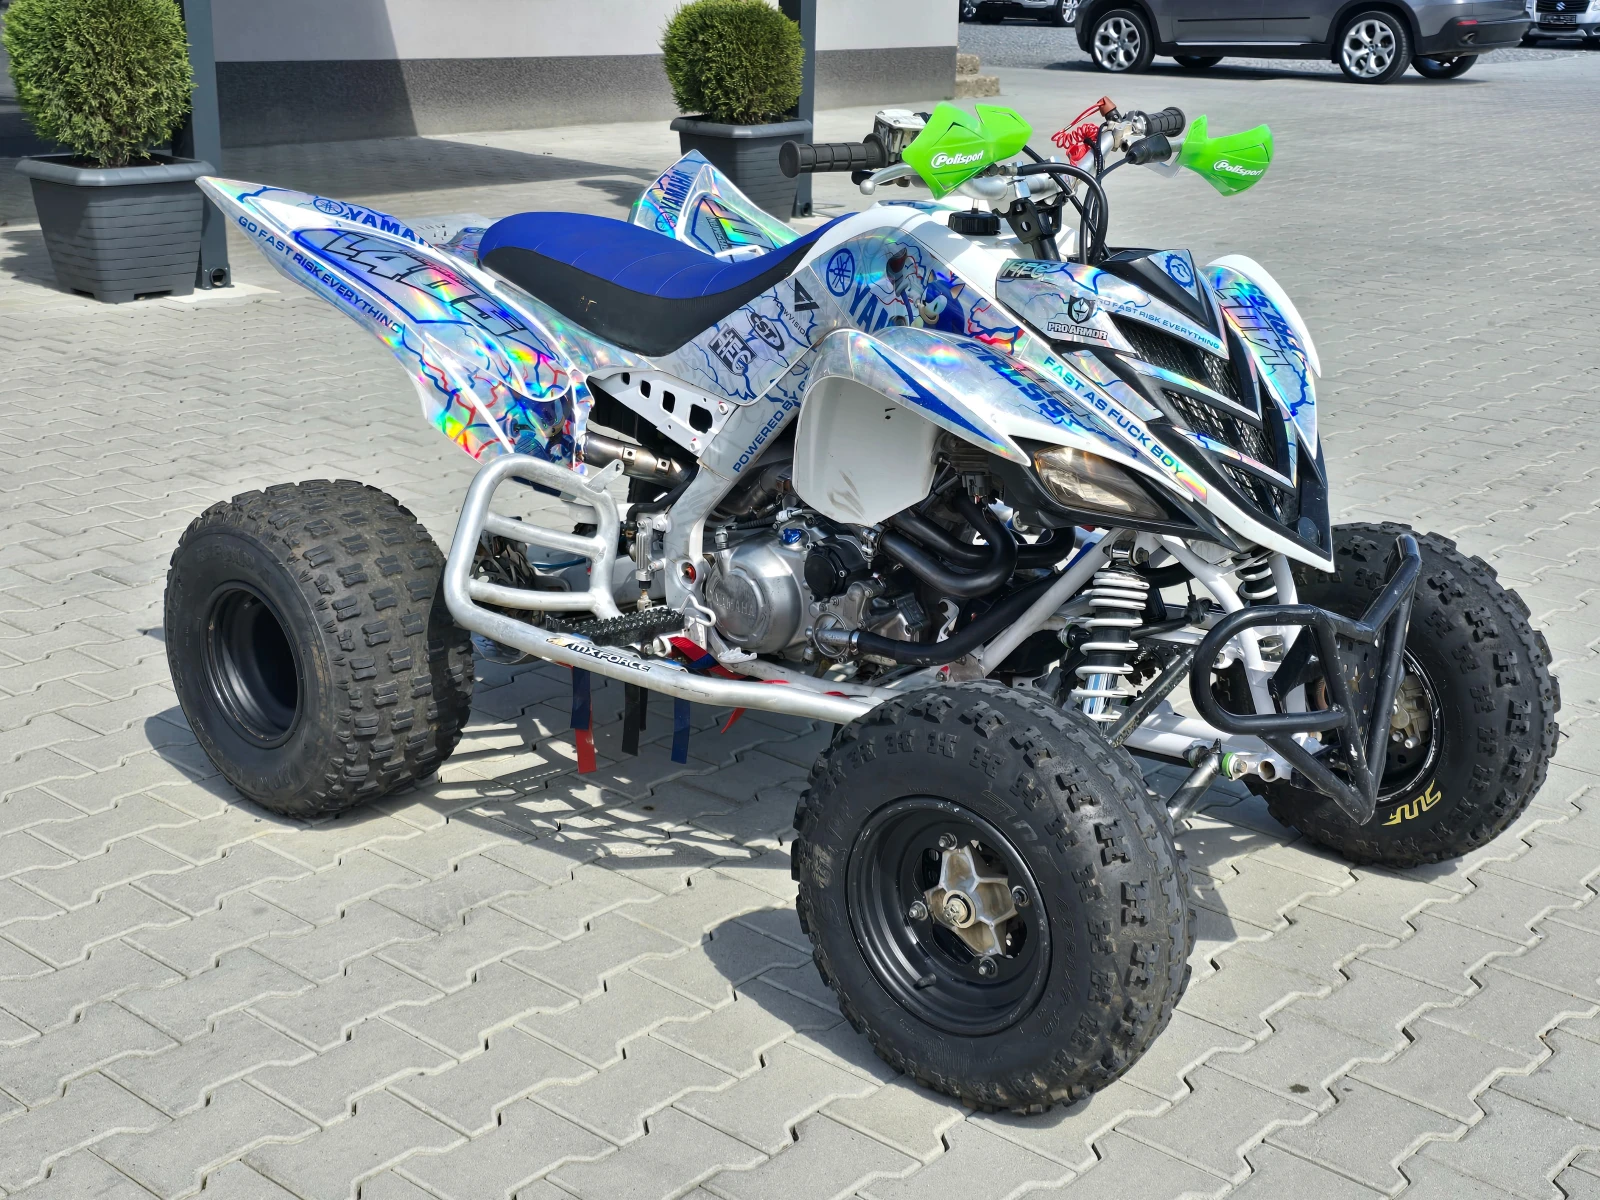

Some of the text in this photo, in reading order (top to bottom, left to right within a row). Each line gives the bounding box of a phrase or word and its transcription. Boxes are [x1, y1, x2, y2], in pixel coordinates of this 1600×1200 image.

[931, 150, 984, 168] Polisport
[1213, 159, 1264, 176] Polisport
[238, 215, 404, 334] GO FAST RISK EVERYTHING
[750, 312, 778, 340] CST
[1112, 302, 1138, 314] FAST
[1139, 311, 1161, 324] RISK
[1162, 319, 1220, 349] EVERYTHING
[732, 391, 798, 473] POWERED BY
[1043, 356, 1184, 476] FAST AS FUCK BOY
